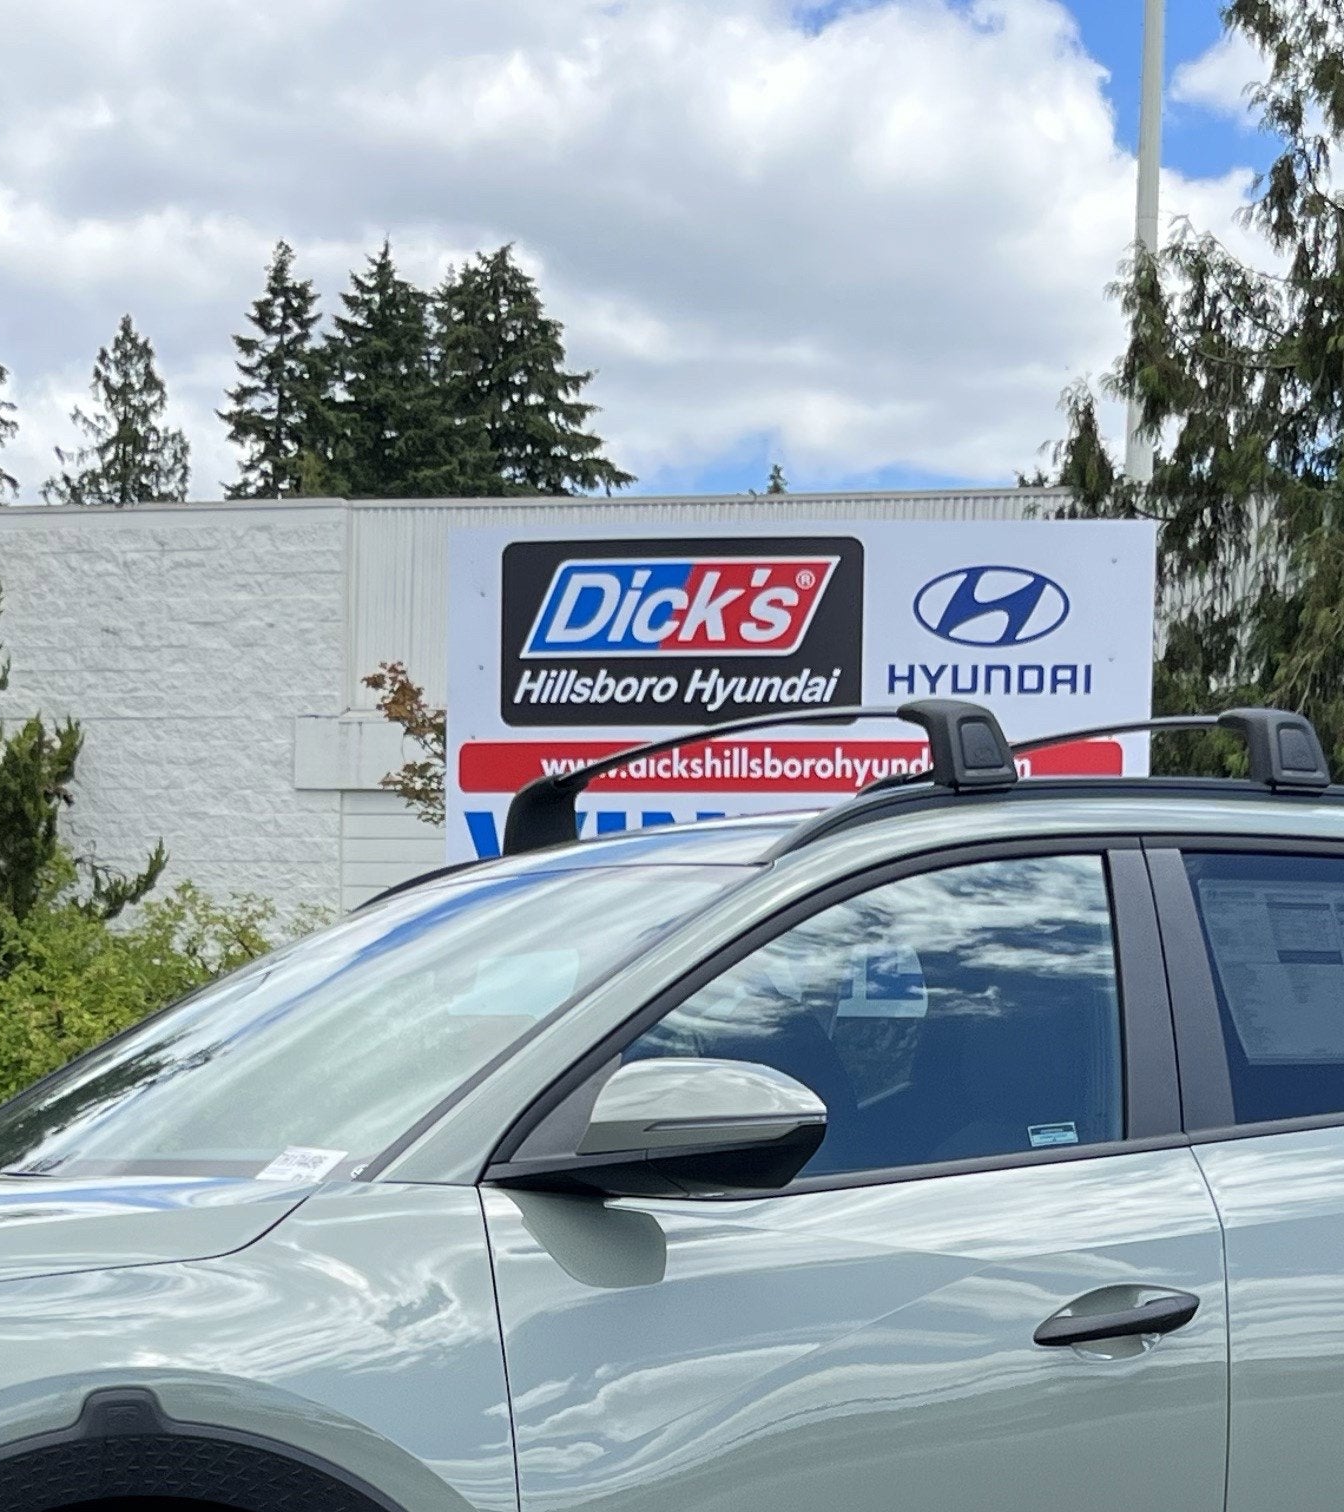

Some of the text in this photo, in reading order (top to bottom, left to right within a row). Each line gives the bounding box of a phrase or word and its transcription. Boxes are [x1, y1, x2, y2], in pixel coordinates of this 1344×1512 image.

[513, 668, 841, 712] Hillsboro Hyundai
[887, 664, 1093, 695] HYUNDAI
